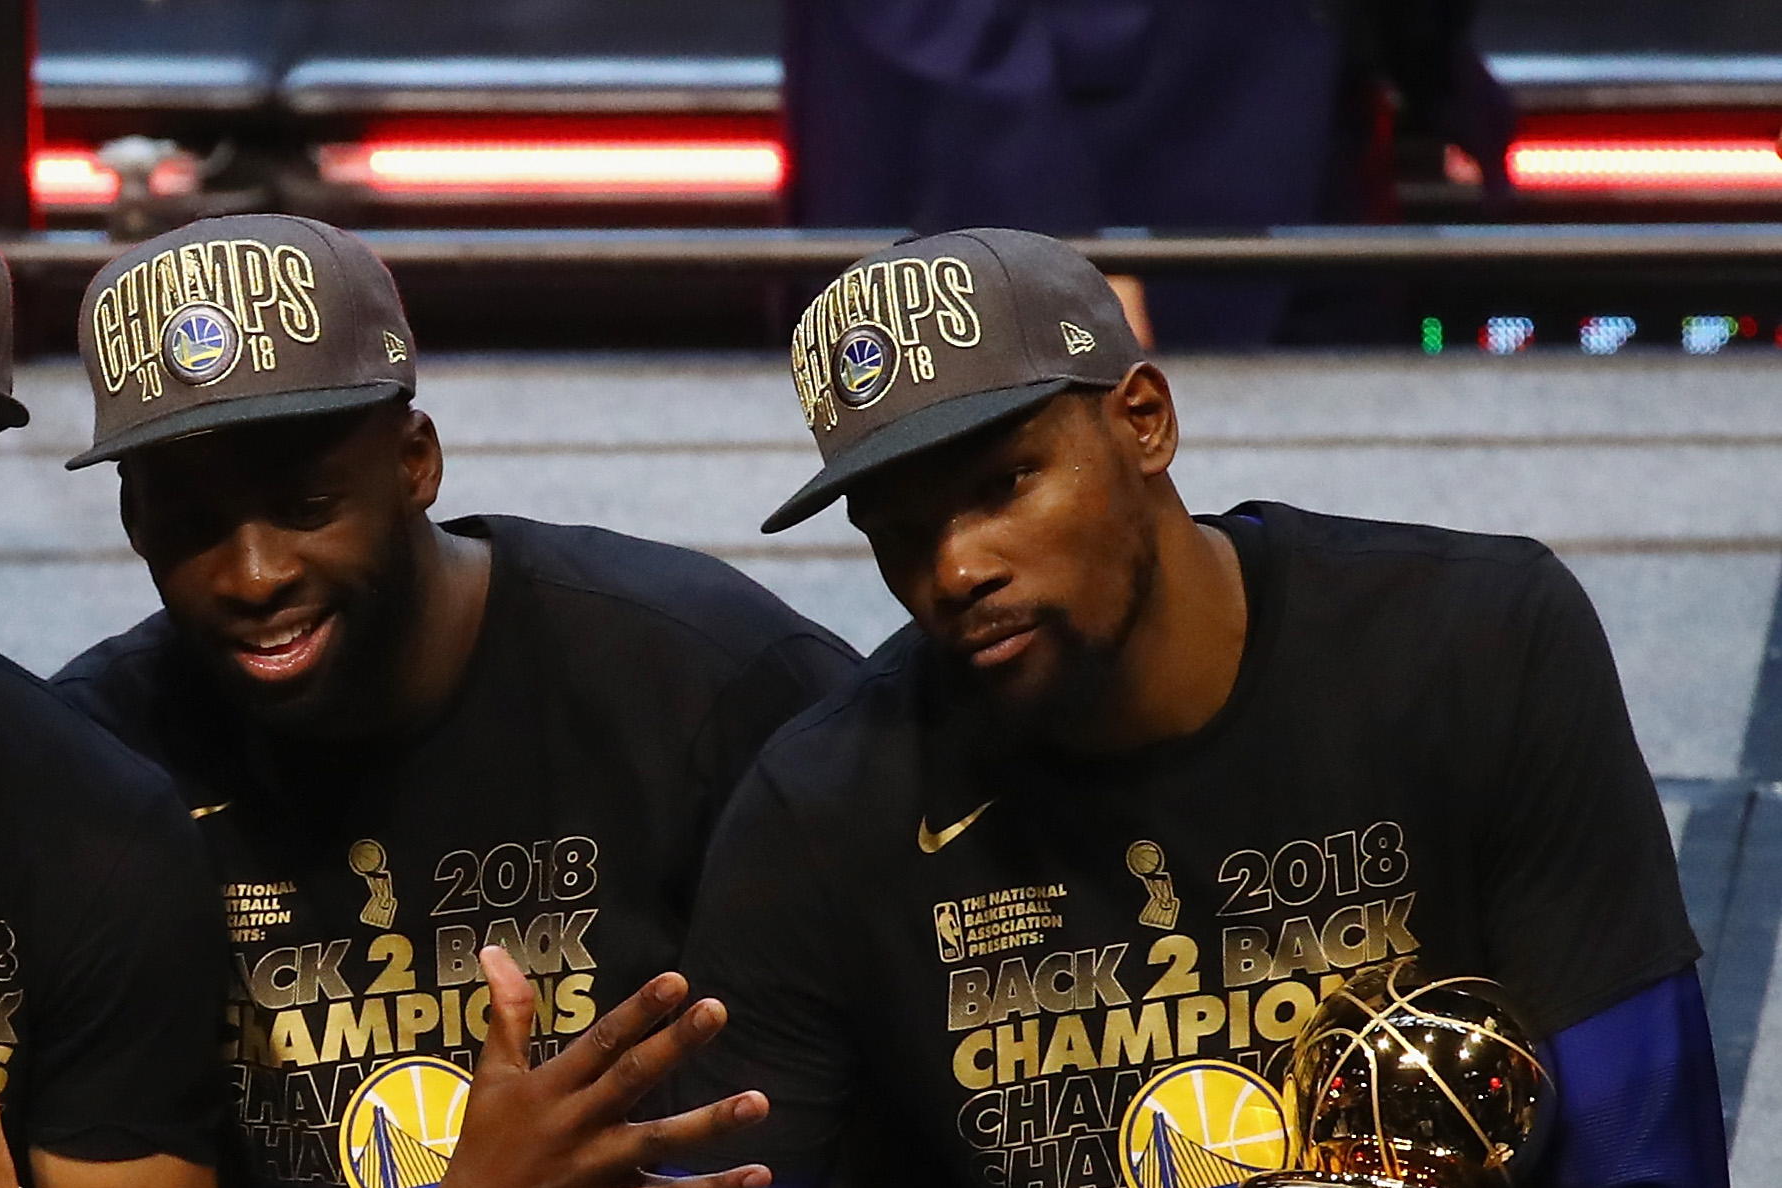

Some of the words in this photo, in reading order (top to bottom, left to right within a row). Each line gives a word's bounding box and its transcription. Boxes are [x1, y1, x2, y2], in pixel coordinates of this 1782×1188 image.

[93, 239, 321, 394] CHAMPS
[792, 256, 982, 430] CHAMPS
[136, 361, 163, 402] 20
[247, 333, 276, 371] 18
[904, 345, 936, 383] 18
[223, 881, 297, 897] ATIONAL
[430, 835, 599, 918] 2018
[961, 895, 987, 913] THE
[988, 883, 1068, 907] NATIONAL
[1215, 821, 1411, 917] 2018
[964, 901, 1052, 928] BASKETBALL
[965, 914, 1064, 943] ASSOCIATION
[236, 938, 352, 1010] CK
[364, 932, 417, 996] 2
[436, 908, 599, 988] BACK
[947, 942, 1133, 1033] BACK
[1142, 933, 1202, 1000] 2
[1221, 890, 1422, 989] BACK
[951, 973, 1346, 1091] CHAMPIO
